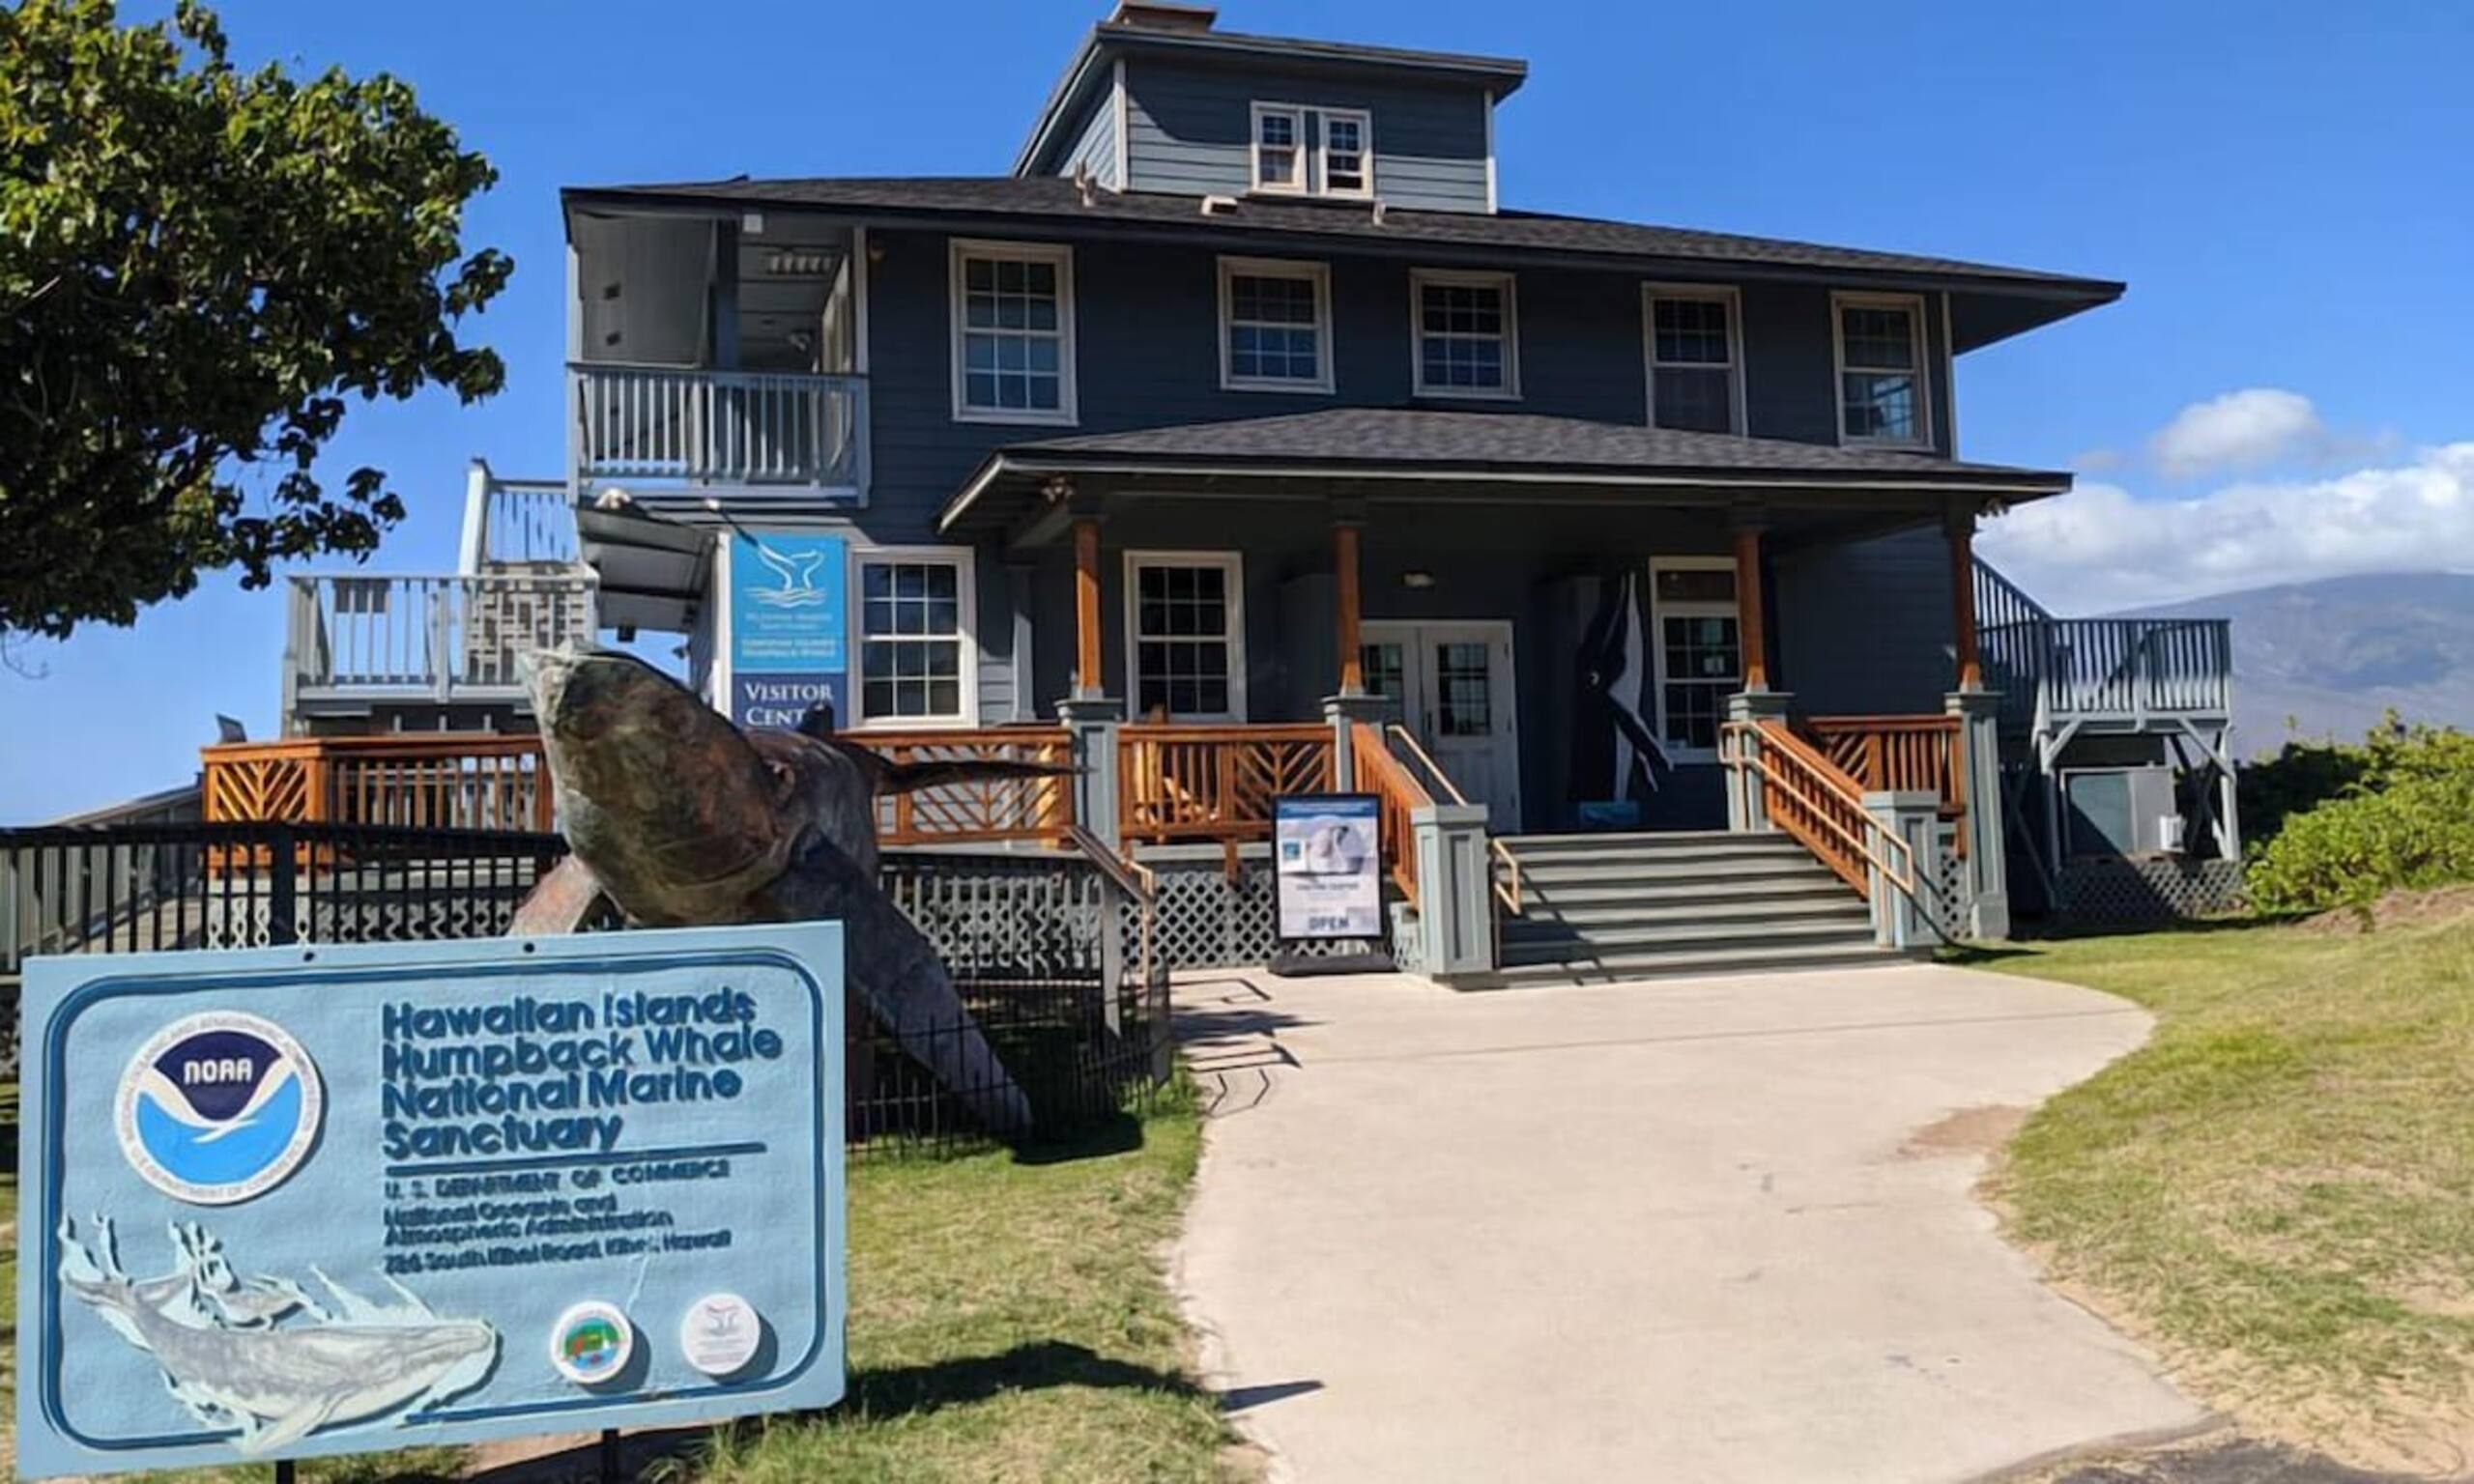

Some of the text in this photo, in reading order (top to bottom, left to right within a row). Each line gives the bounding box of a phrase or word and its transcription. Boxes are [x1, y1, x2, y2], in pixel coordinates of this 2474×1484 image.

[744, 681, 833, 702] VISITOR
[745, 706, 807, 727] CENT
[383, 986, 757, 1041] Hawaiian Islands
[184, 1058, 254, 1086] NOAA
[383, 1021, 784, 1082] Humpback Whale
[383, 1068, 743, 1119] National Marine
[383, 1114, 624, 1158] Sanctuary
